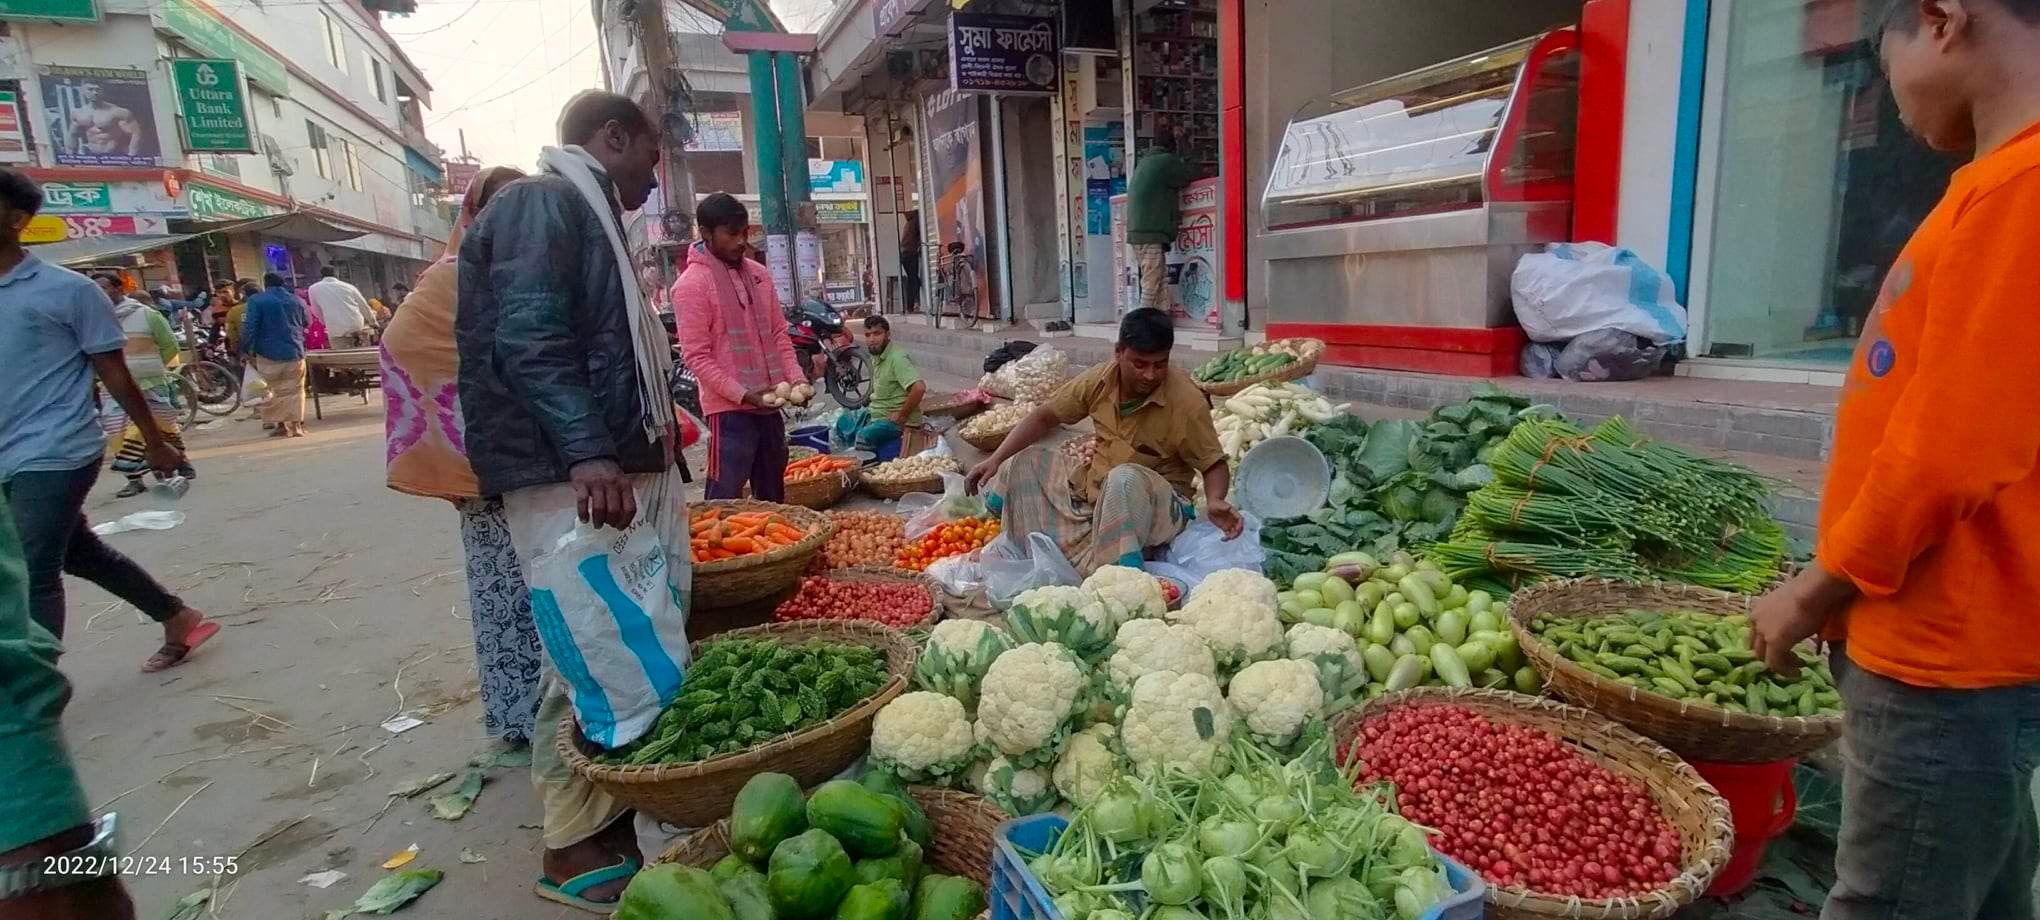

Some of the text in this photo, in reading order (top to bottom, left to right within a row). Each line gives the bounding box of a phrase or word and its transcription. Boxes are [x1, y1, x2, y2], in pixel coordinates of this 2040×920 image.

[958, 26, 991, 56] সুমা
[995, 22, 1053, 52] ফার্মেসী
[189, 88, 233, 99] Uttara
[196, 102, 231, 114] Bank
[190, 116, 243, 128] Limited
